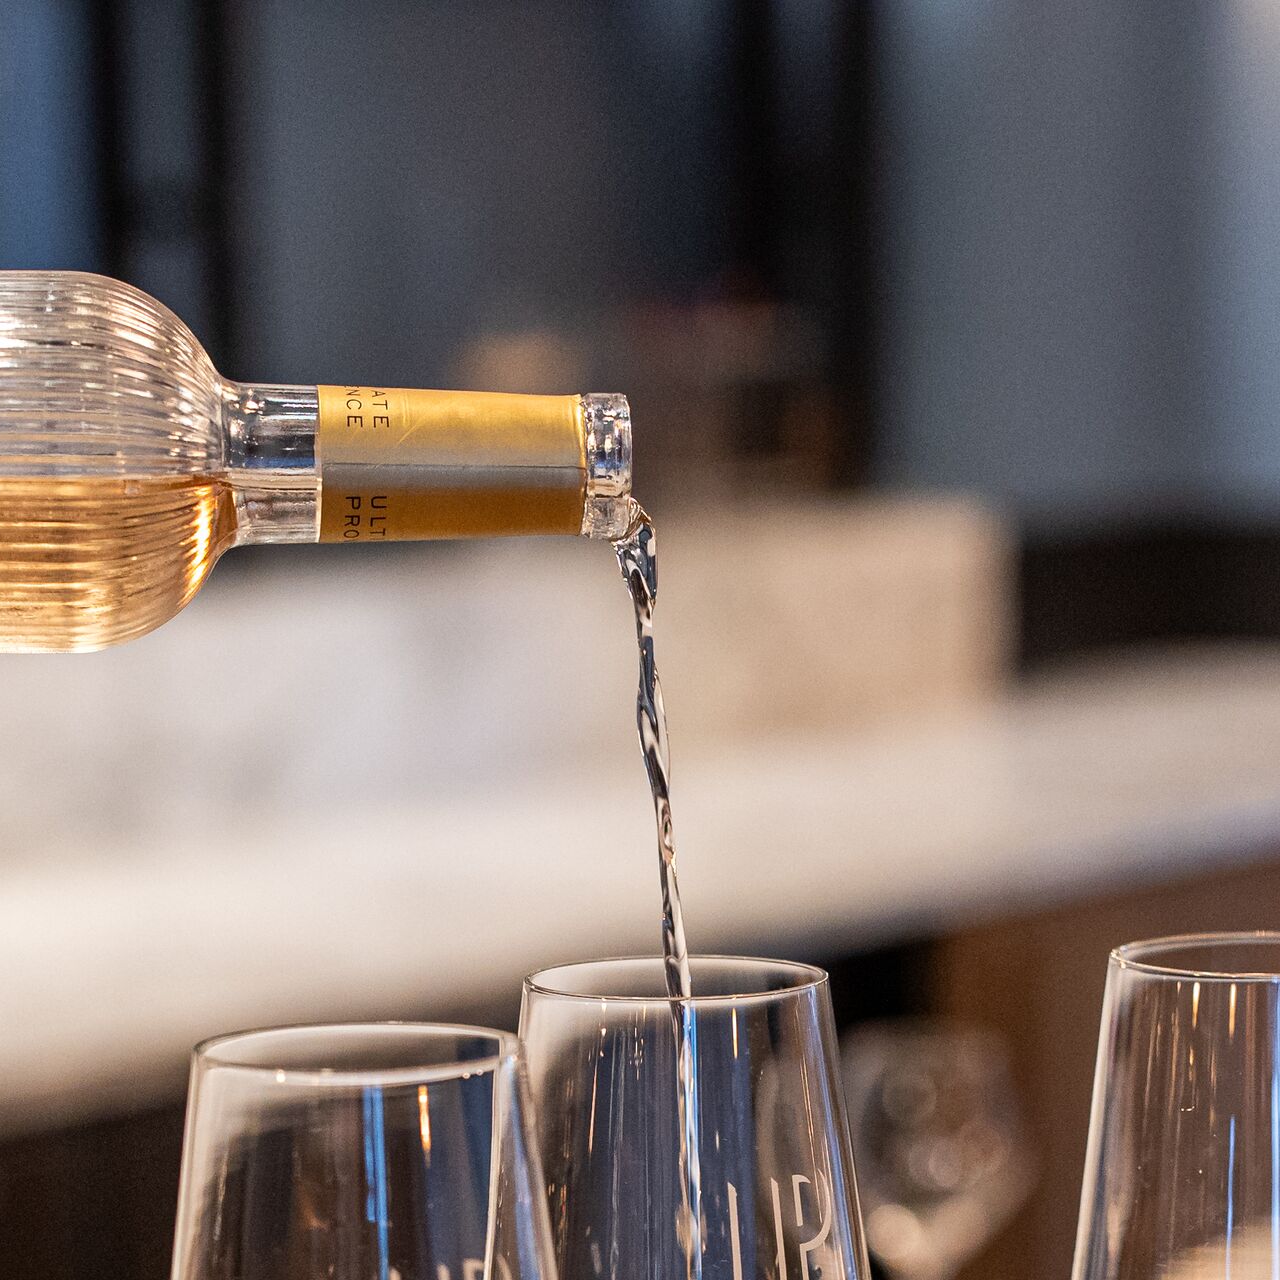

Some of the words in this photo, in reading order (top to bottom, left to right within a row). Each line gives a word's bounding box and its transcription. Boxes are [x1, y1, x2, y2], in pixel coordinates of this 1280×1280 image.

[344, 384, 363, 428] NCE
[370, 389, 389, 428] ATE
[343, 496, 361, 540] PRO
[369, 495, 387, 539] ULT
